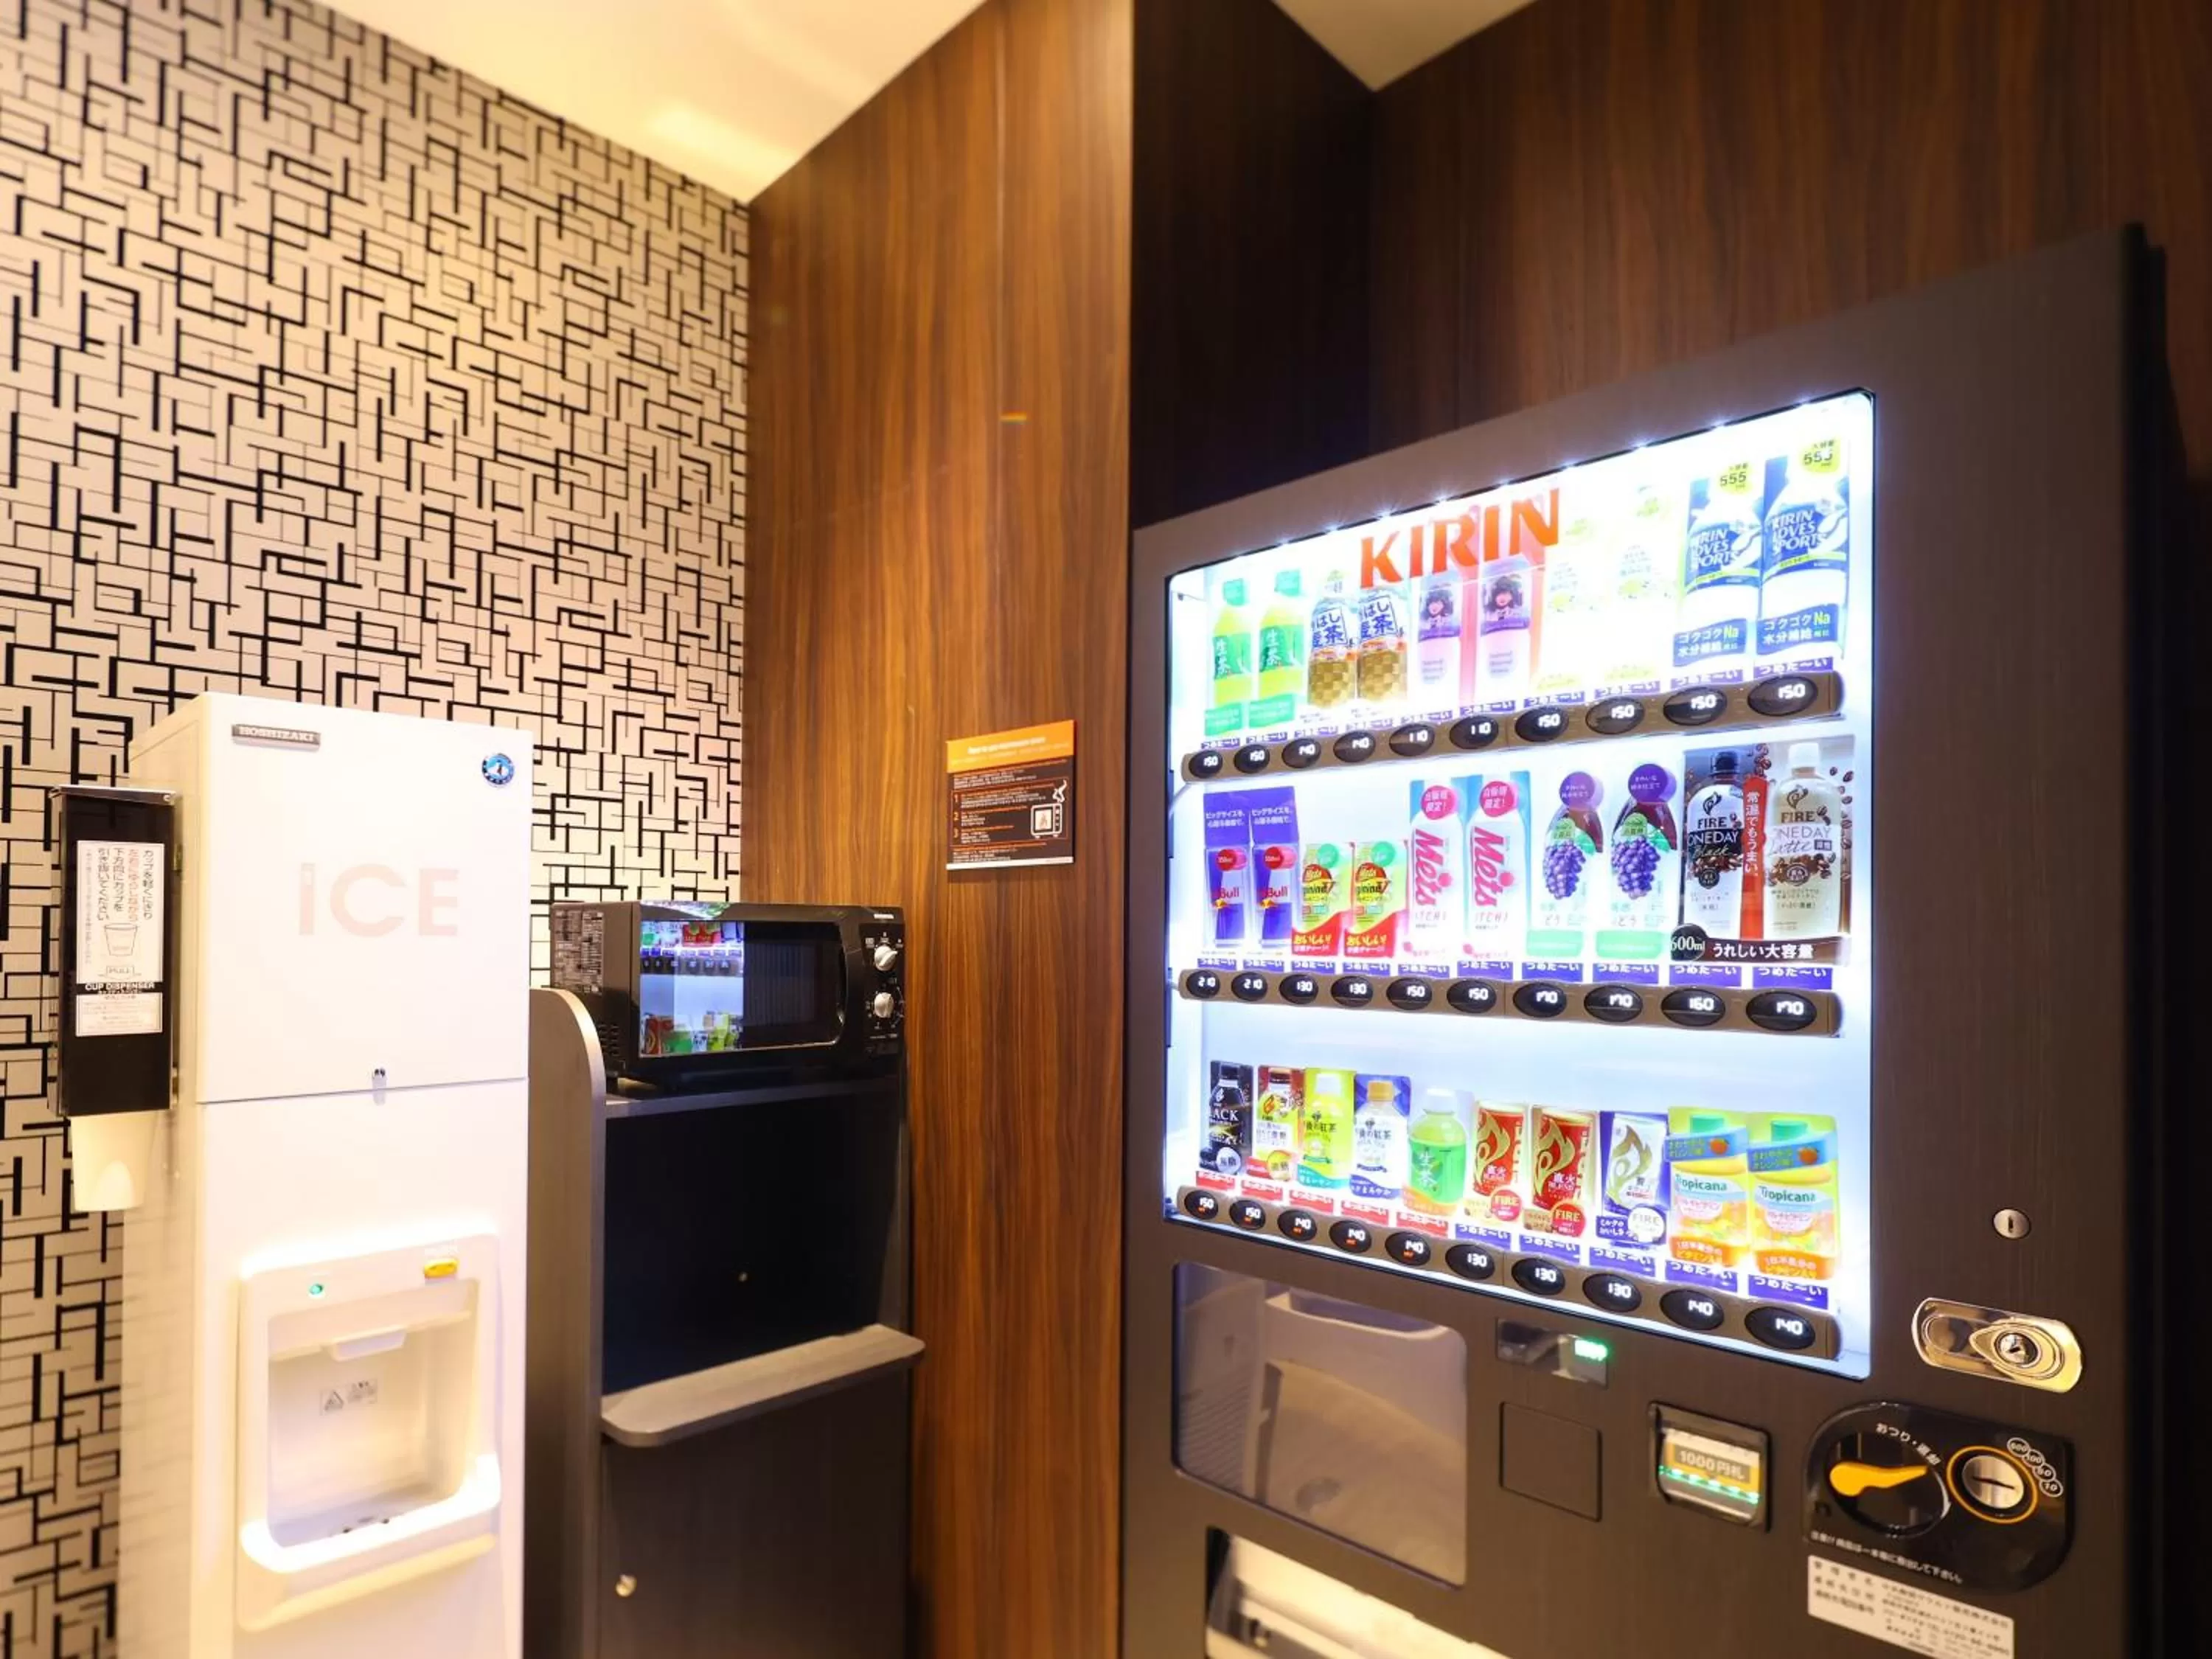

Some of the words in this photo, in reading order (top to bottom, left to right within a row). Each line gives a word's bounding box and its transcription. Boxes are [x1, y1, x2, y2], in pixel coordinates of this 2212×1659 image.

[1720, 471, 1747, 487] 555
[1360, 489, 1559, 588] KIRIN
[1778, 683, 1806, 699] 150
[1691, 694, 1717, 709] 150
[1611, 704, 1635, 718] 150
[1539, 714, 1560, 727] 150
[240, 726, 313, 742] HOSHIZAKI
[1352, 737, 1370, 748] 140
[1251, 750, 1265, 761] 150
[1299, 744, 1315, 755] 140
[1204, 756, 1218, 766] 150
[1697, 816, 1728, 829] FIRE
[1781, 811, 1815, 824] FIRE
[1688, 830, 1739, 845] ONEDAY
[1415, 827, 1444, 906] Mets
[1474, 826, 1505, 907] Mets
[1220, 887, 1239, 898] Bull
[1267, 886, 1287, 897] Bull
[1672, 935, 1705, 951] 600ml
[1713, 943, 1814, 959] うれしい大容量
[1198, 977, 1215, 987] 210
[1244, 979, 1262, 990] 210
[1297, 981, 1312, 992] 130
[1350, 983, 1367, 994] 130
[1407, 985, 1425, 997] 150
[1469, 988, 1488, 1000] 150
[1537, 991, 1557, 1004] 170
[1610, 994, 1632, 1008] 170
[1777, 1001, 1804, 1015] 170
[1304, 1120, 1336, 1133] 後の紅茶
[1356, 1127, 1391, 1139] 後の紅茶
[1419, 1150, 1438, 1189] 生茶
[1674, 1173, 1728, 1192] Tropicana
[1759, 1186, 1816, 1203] Tropicana
[1199, 1197, 1214, 1209] 150
[1246, 1208, 1261, 1218] 150
[1555, 1210, 1582, 1222] FIRE
[1632, 1213, 1660, 1224] FIRE
[1295, 1218, 1311, 1229] 140
[1349, 1229, 1366, 1241] 140
[1406, 1241, 1424, 1253] 140
[1468, 1253, 1487, 1267] 130
[1536, 1268, 1557, 1282] 130
[1609, 1283, 1631, 1298] 130
[1688, 1300, 1714, 1315] 140
[1776, 1318, 1803, 1335] 140
[1679, 1449, 1746, 1481] 1000円札
